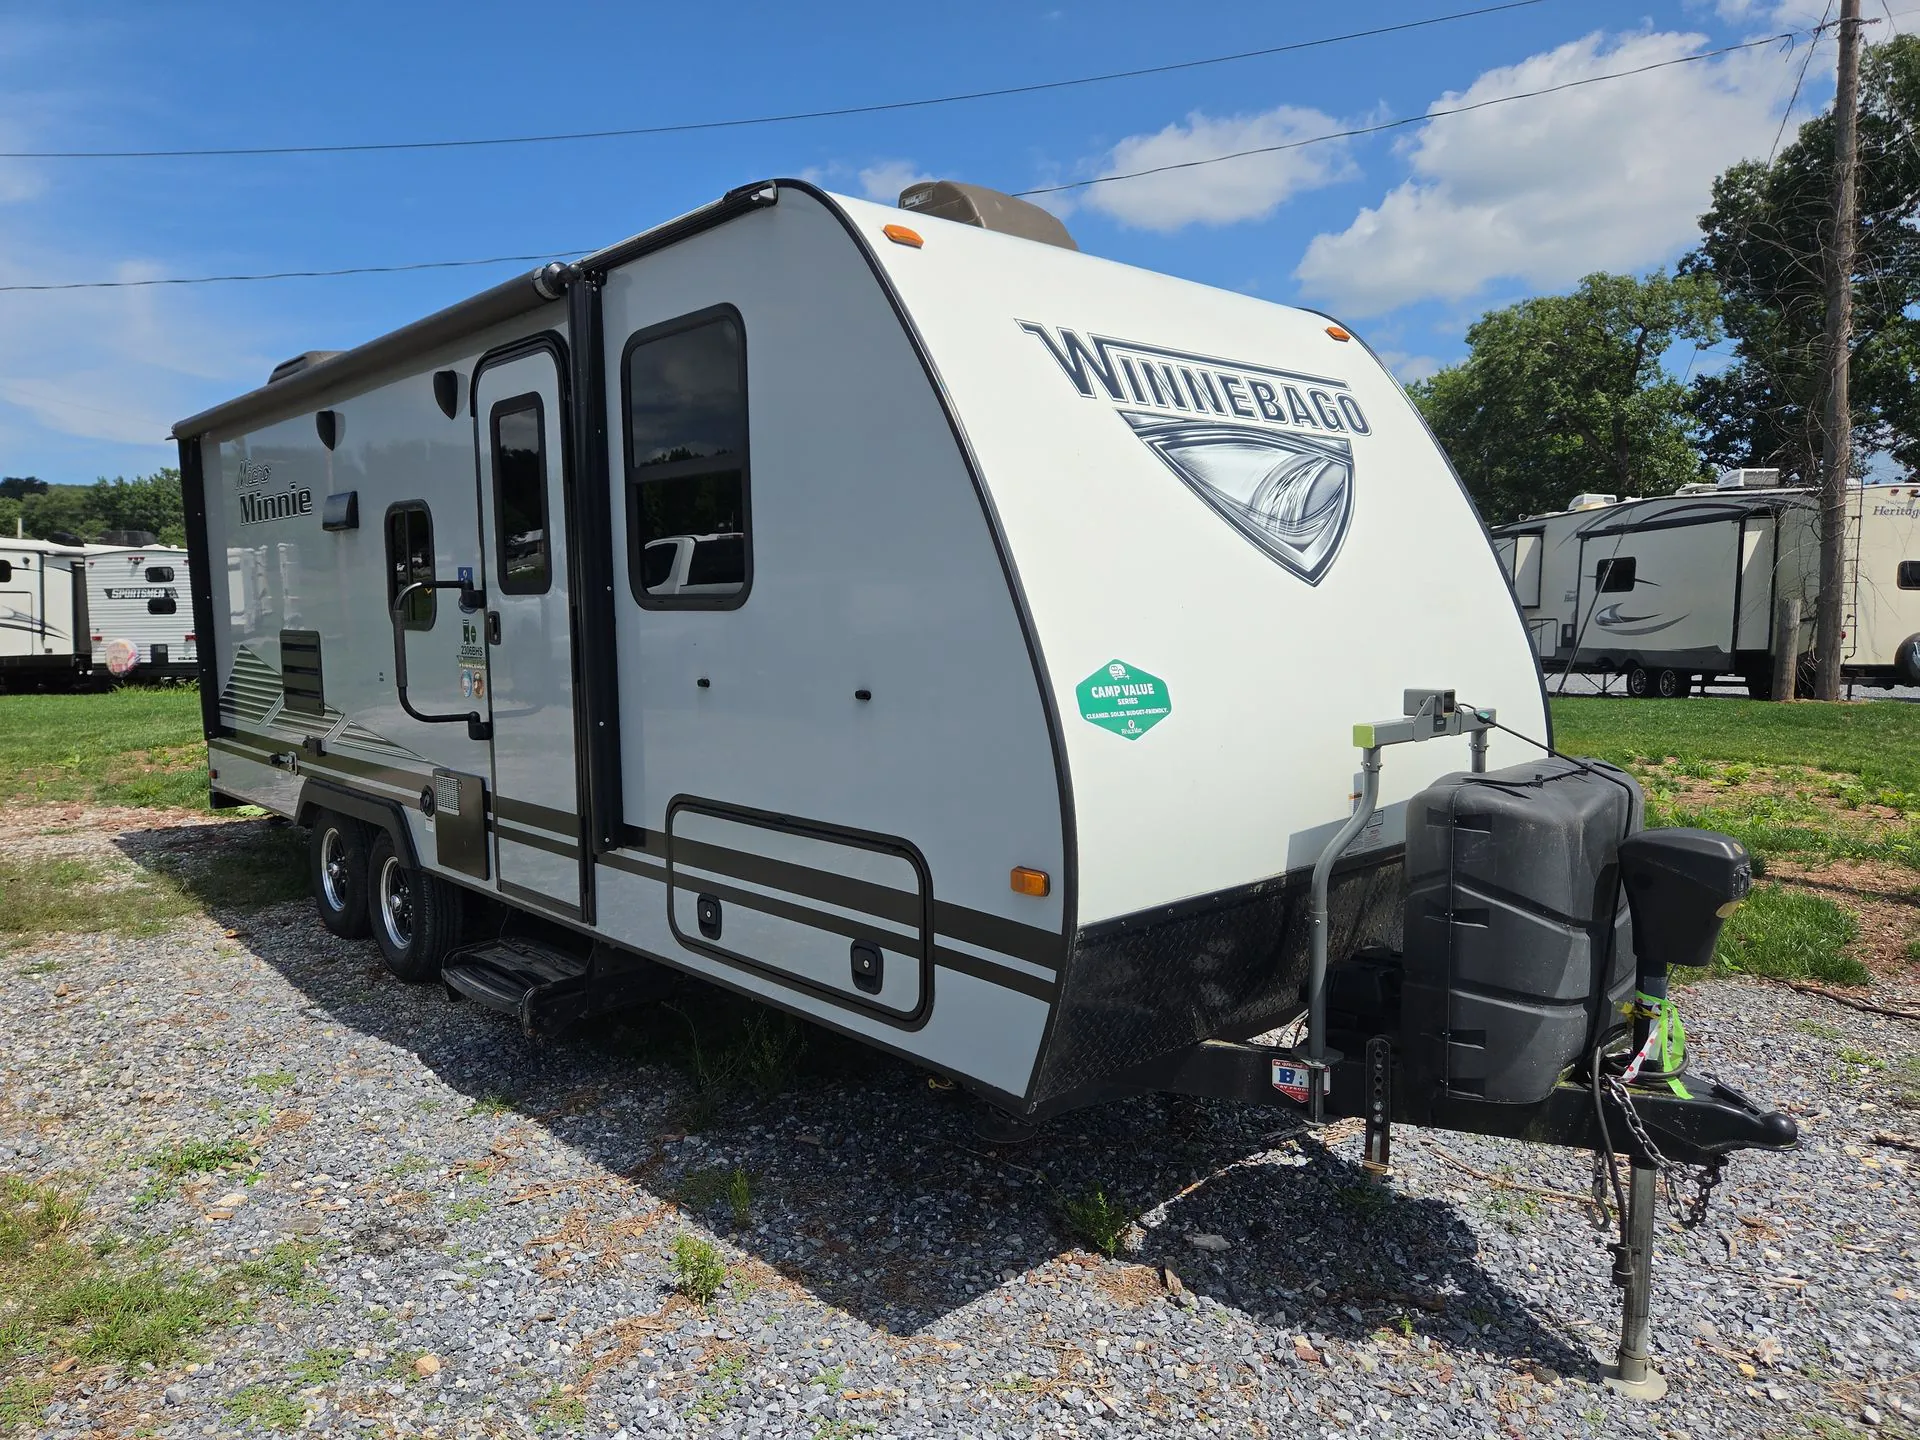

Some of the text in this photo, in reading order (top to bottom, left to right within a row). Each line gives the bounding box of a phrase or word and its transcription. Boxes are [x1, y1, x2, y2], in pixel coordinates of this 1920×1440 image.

[1014, 318, 1372, 437] WINNEBAGO
[235, 458, 271, 490] Micro
[239, 482, 312, 525] Minnie
[1872, 505, 1920, 519] Heritag
[111, 588, 165, 599] SPORTSMEN
[1091, 683, 1155, 699] CAMP VALUE
[1117, 697, 1139, 705] SERIES
[1279, 1068, 1309, 1086] BA
